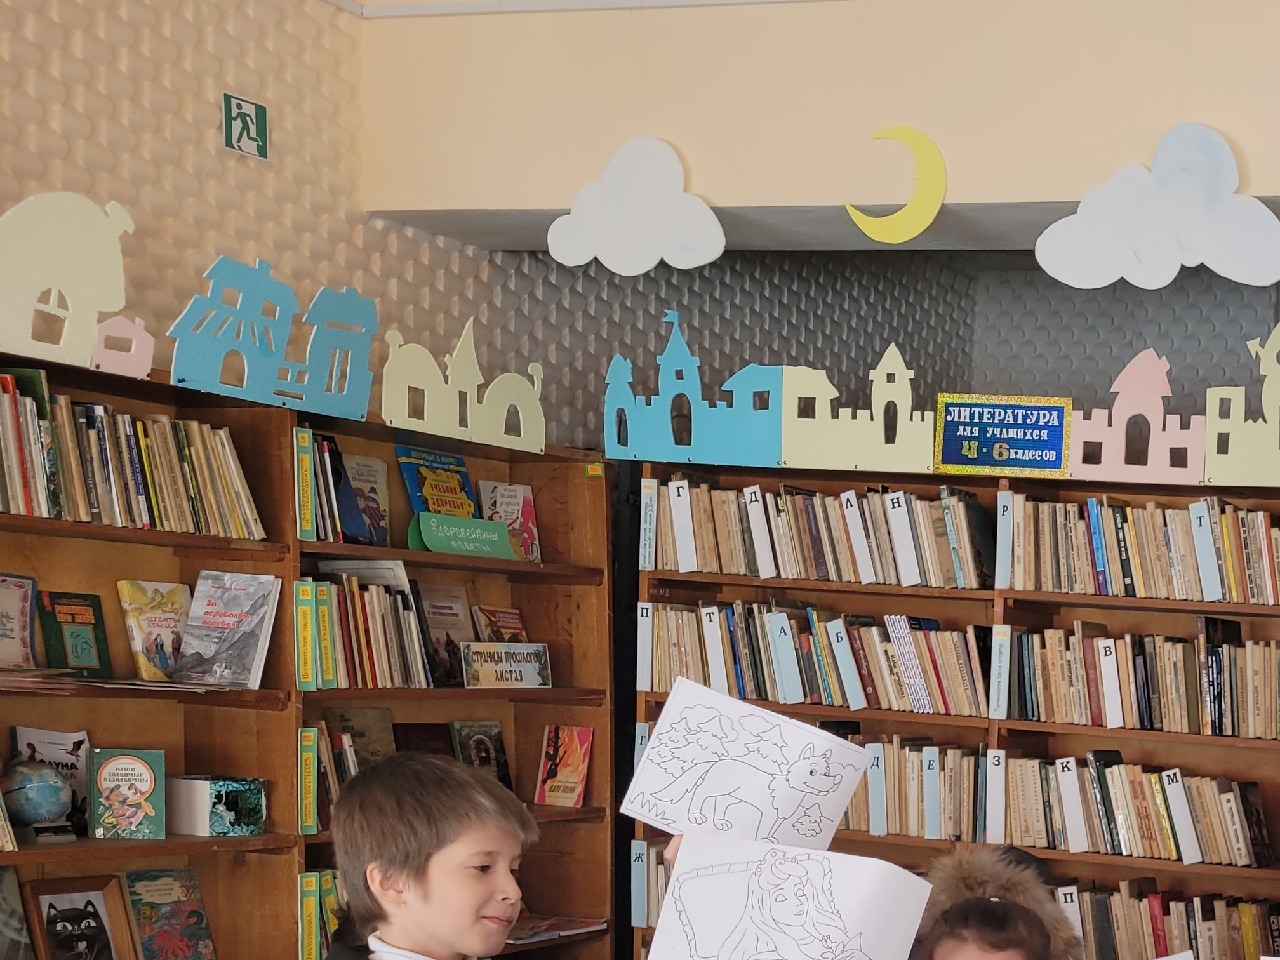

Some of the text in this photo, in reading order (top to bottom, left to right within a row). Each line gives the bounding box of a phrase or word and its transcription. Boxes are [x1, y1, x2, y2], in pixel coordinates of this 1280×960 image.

[946, 407, 1059, 426] ЛИТЕРАТУРА
[957, 426, 1048, 440] ДЛЯ УЧАЩИХСЯ
[676, 486, 684, 497] Г
[748, 491, 760, 504] Д
[844, 497, 854, 509] Л
[890, 497, 902, 510] Н
[1001, 504, 1009, 517] Р
[1197, 515, 1205, 528] Т
[640, 608, 649, 618] П
[705, 612, 714, 623] Т
[777, 626, 788, 638] А
[835, 631, 844, 643] Б
[1103, 645, 1114, 657] В
[869, 756, 880, 770] Д
[926, 758, 936, 771] Е
[992, 755, 1000, 767] З
[1060, 761, 1073, 773] К
[1166, 771, 1181, 787] М
[633, 852, 645, 863] Ж
[1062, 892, 1075, 904] П
